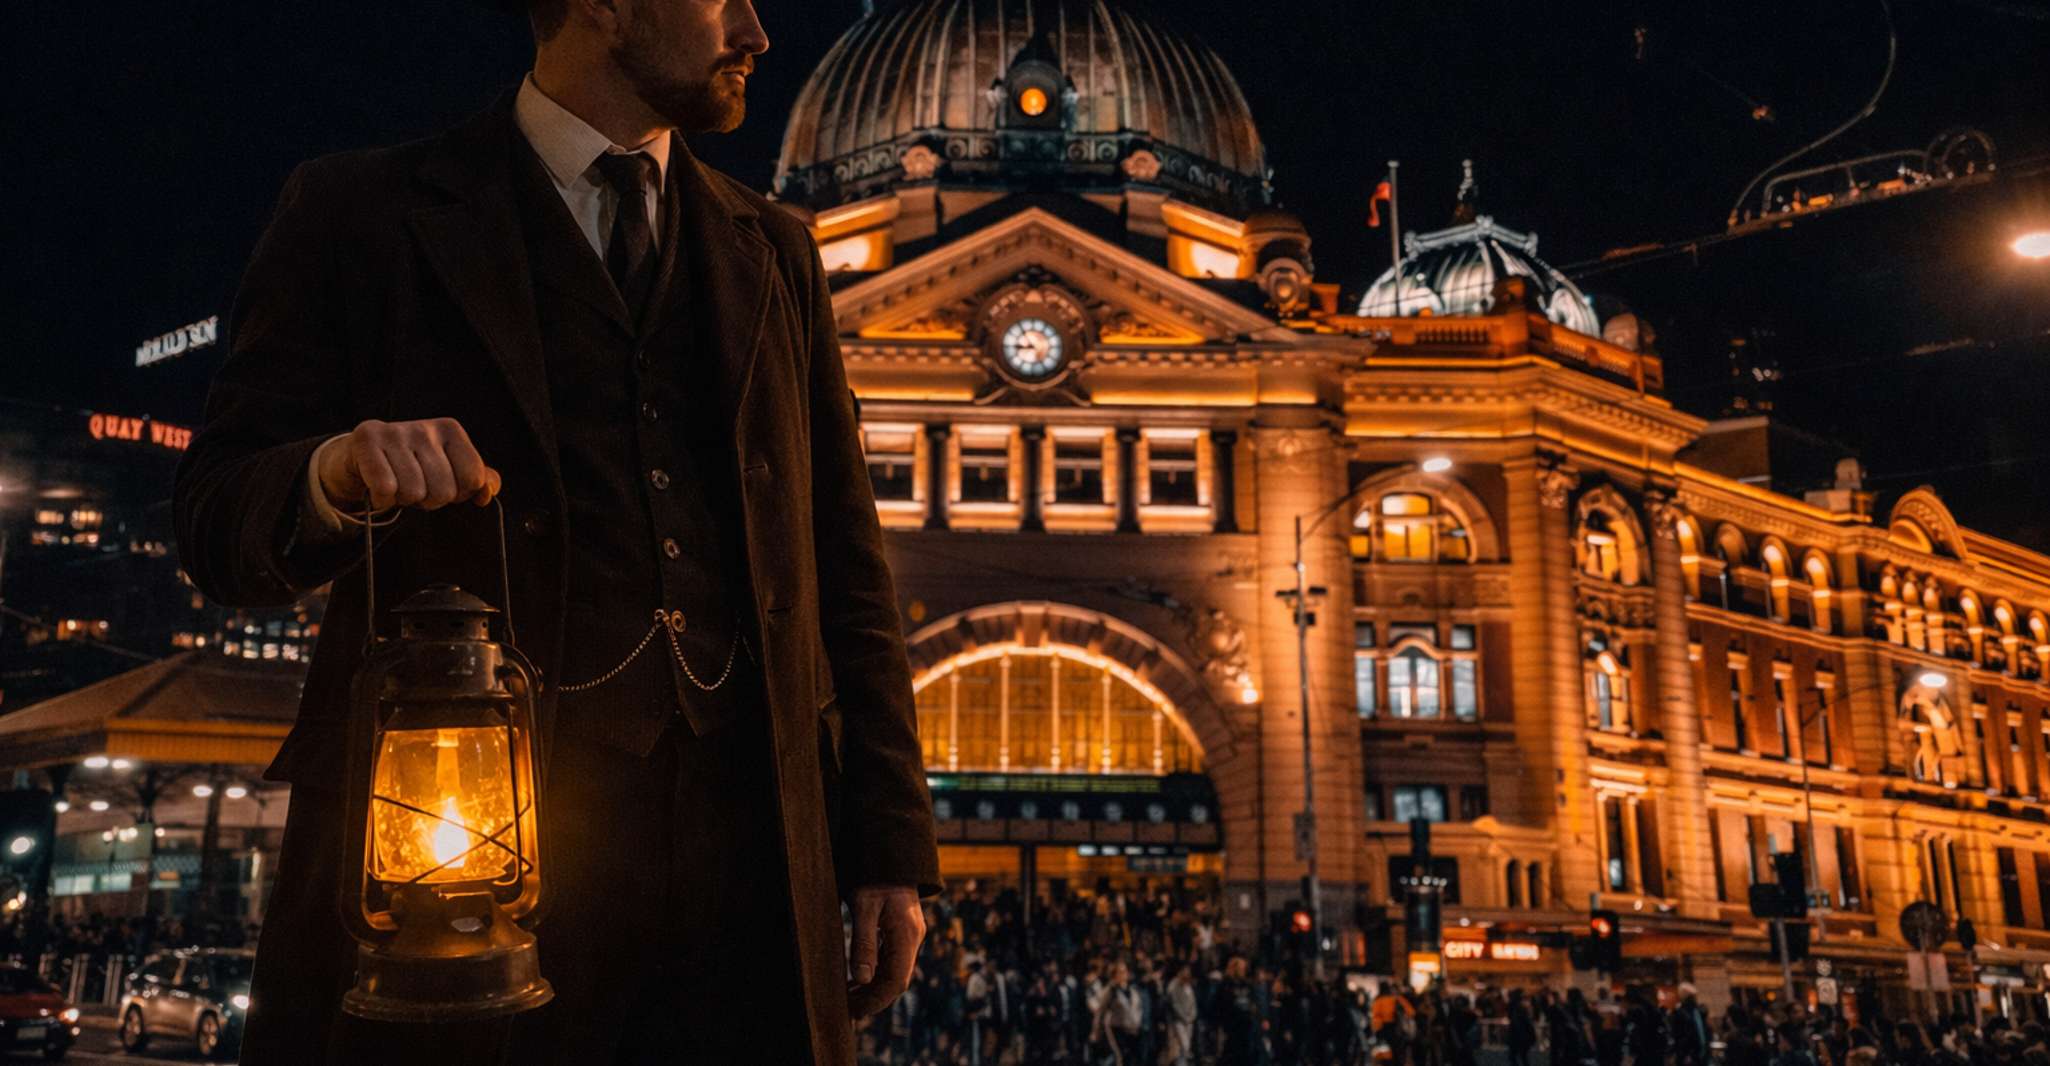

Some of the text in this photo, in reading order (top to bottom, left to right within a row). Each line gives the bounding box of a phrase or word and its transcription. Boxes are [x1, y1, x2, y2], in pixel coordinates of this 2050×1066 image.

[90, 413, 192, 450] QUAY WEST
[1445, 941, 1484, 958] CITY
